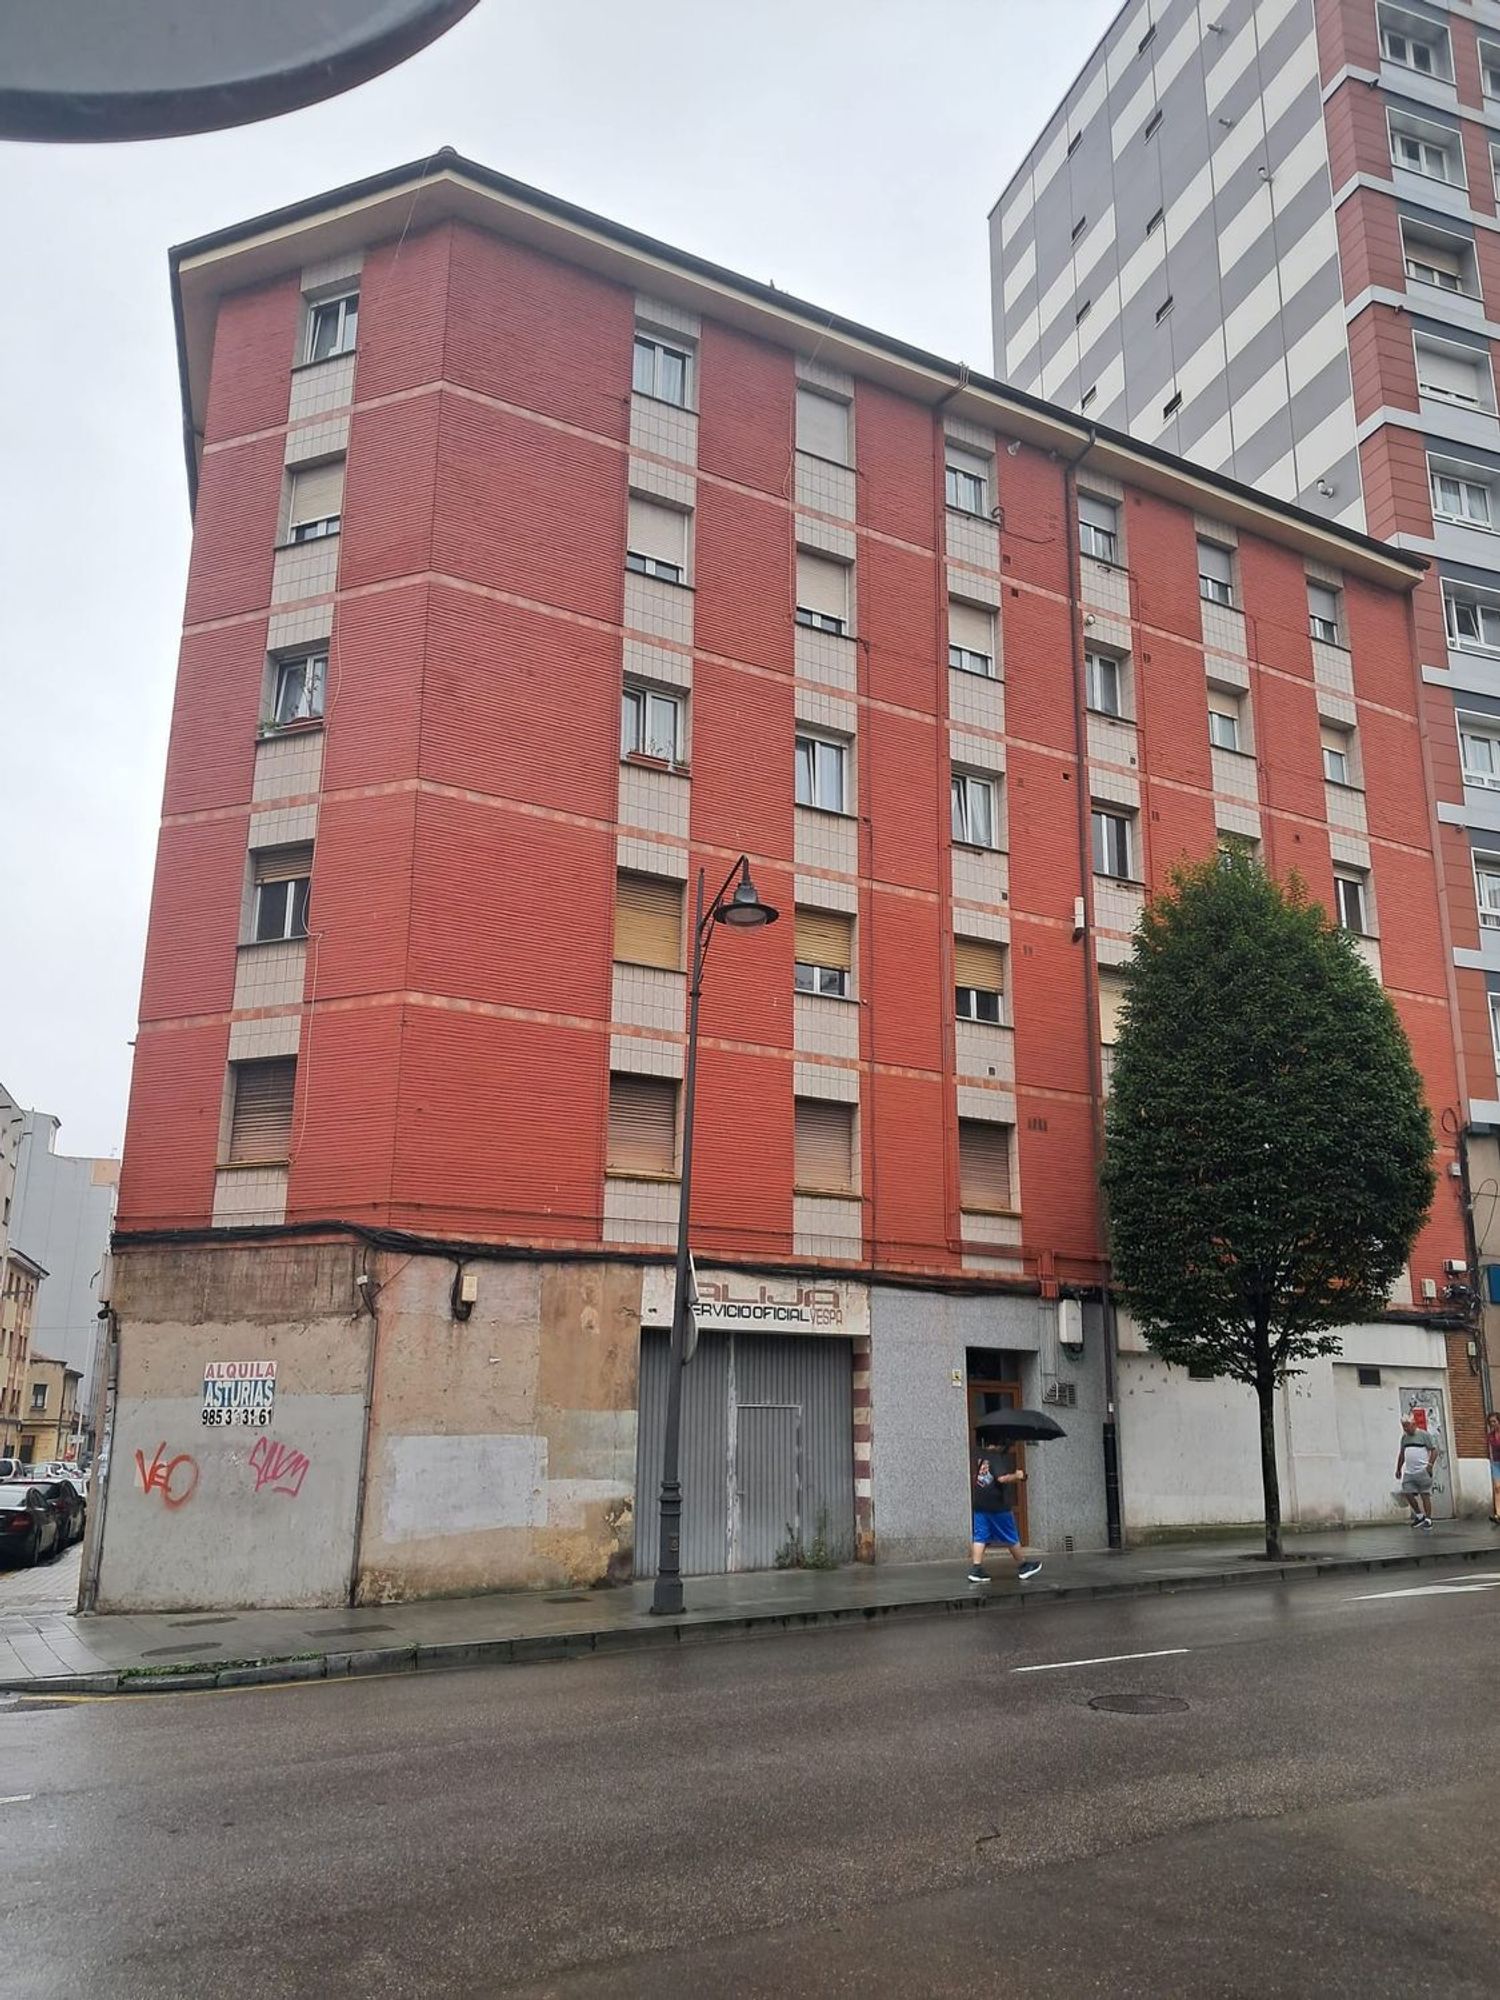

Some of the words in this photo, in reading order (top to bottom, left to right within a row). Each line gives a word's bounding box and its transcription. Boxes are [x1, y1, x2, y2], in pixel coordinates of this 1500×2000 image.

[690, 1302, 751, 1319] ERVICIO
[752, 1305, 810, 1322] OFICIAL
[810, 1308, 843, 1325] VESPA
[205, 1362, 274, 1379] ALQUILA
[204, 1380, 274, 1407] ASTURIAS
[202, 1409, 223, 1425] 985
